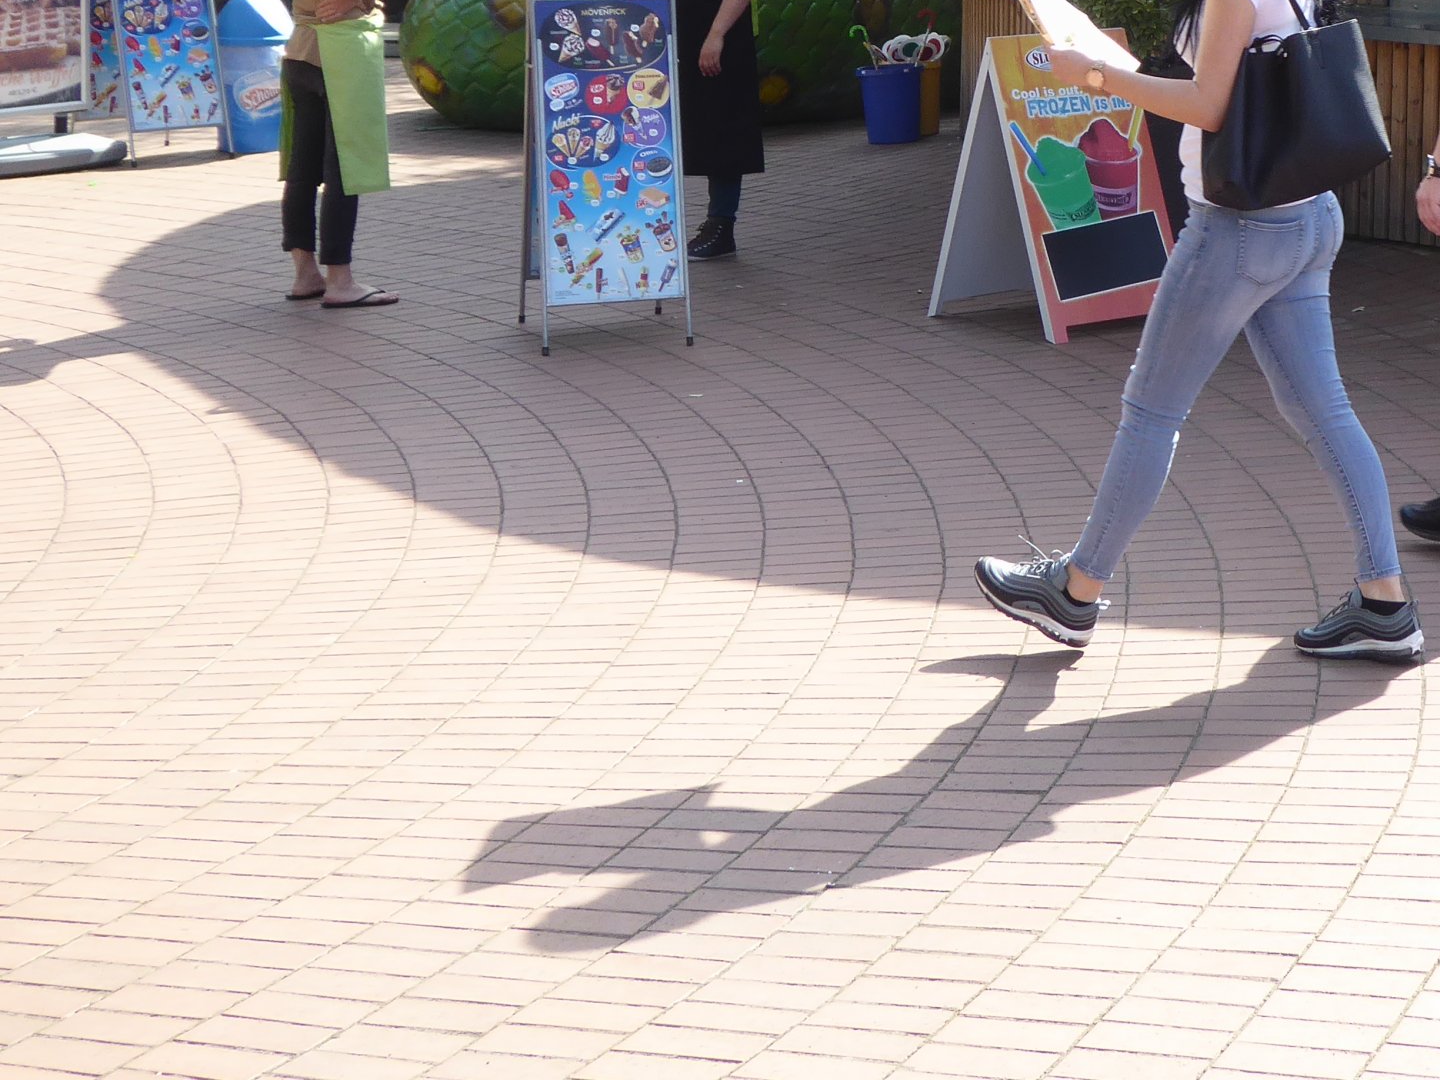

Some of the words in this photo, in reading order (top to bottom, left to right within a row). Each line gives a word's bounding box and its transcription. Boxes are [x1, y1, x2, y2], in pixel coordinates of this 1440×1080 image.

[581, 8, 627, 16] MÖVENPICK
[1011, 87, 1040, 100] Cool
[1044, 86, 1056, 97] is
[1058, 85, 1084, 96] out.
[1026, 96, 1092, 117] FROZEN
[1094, 98, 1110, 111] IS
[551, 113, 581, 133] Nucki
